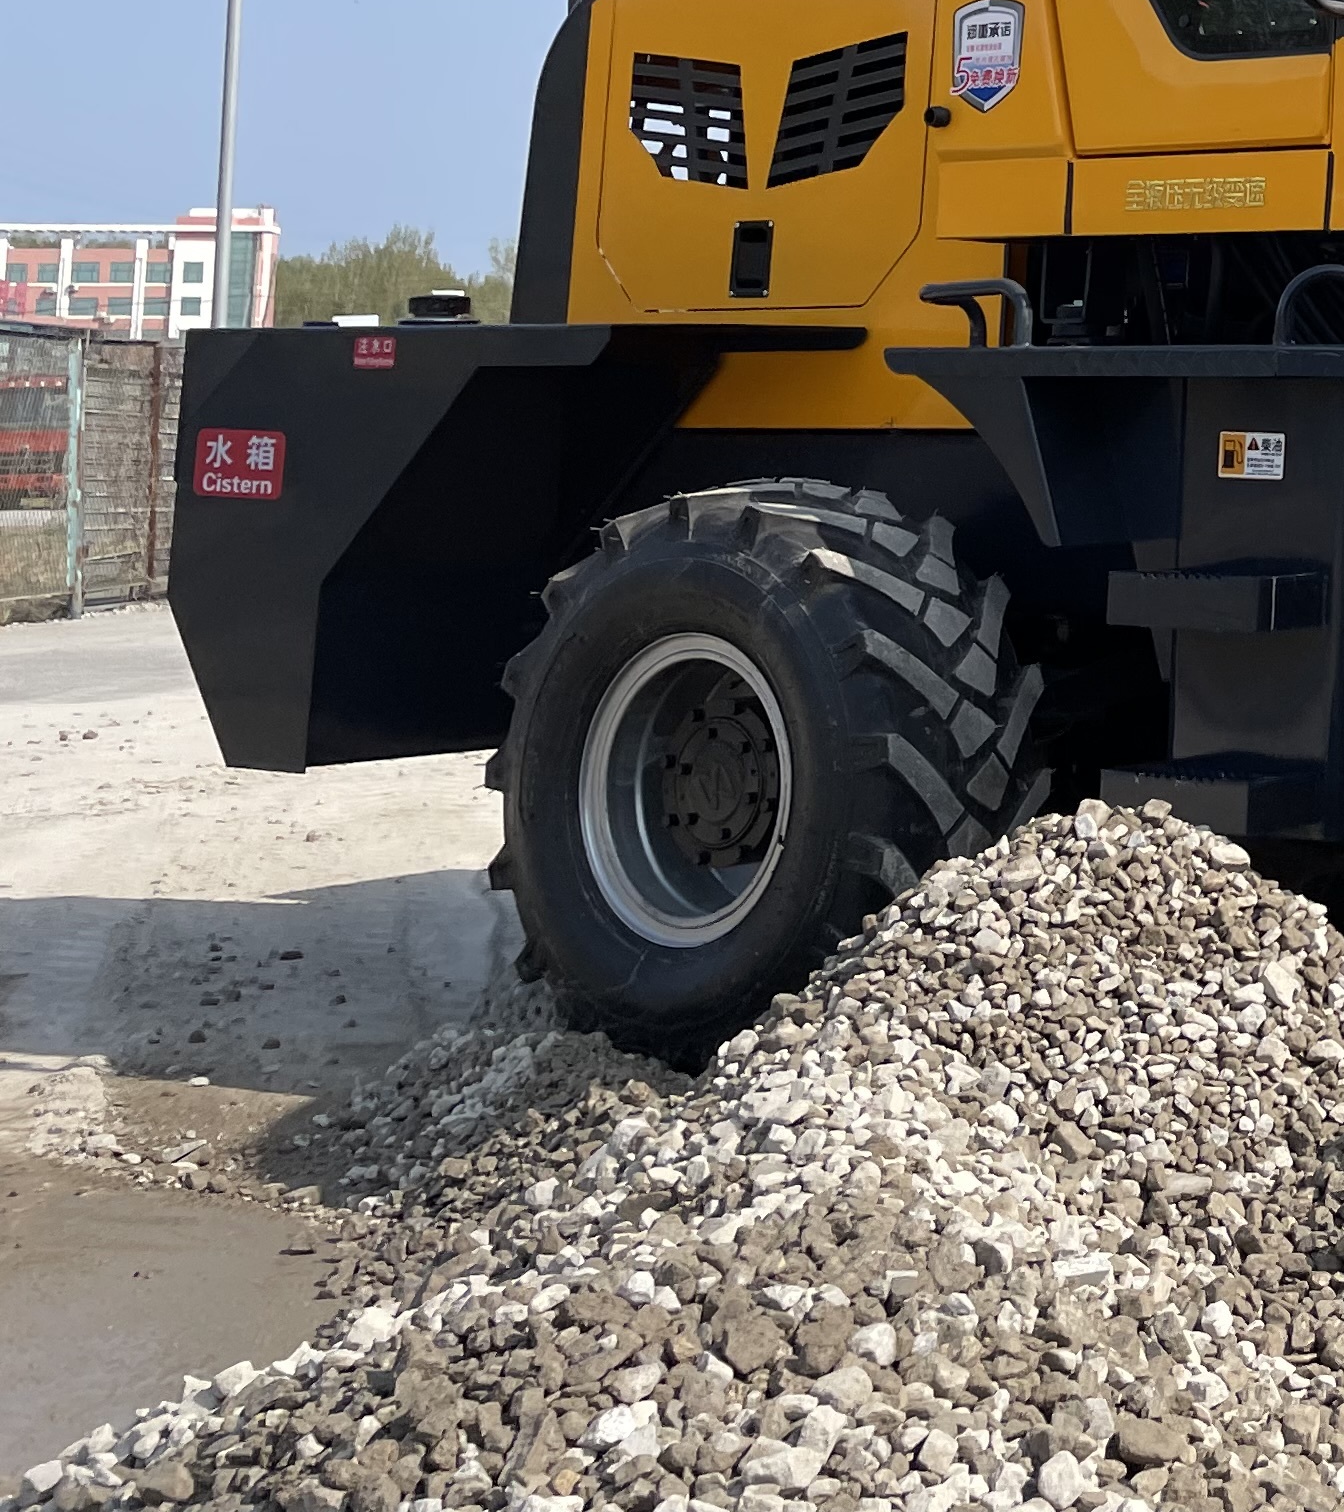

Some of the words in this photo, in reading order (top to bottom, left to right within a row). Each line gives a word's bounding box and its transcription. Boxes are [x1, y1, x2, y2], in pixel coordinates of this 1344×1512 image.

[1124, 176, 1266, 212] 全液压无级变速
[205, 434, 277, 471] 水箱
[202, 472, 273, 495] Cistern
